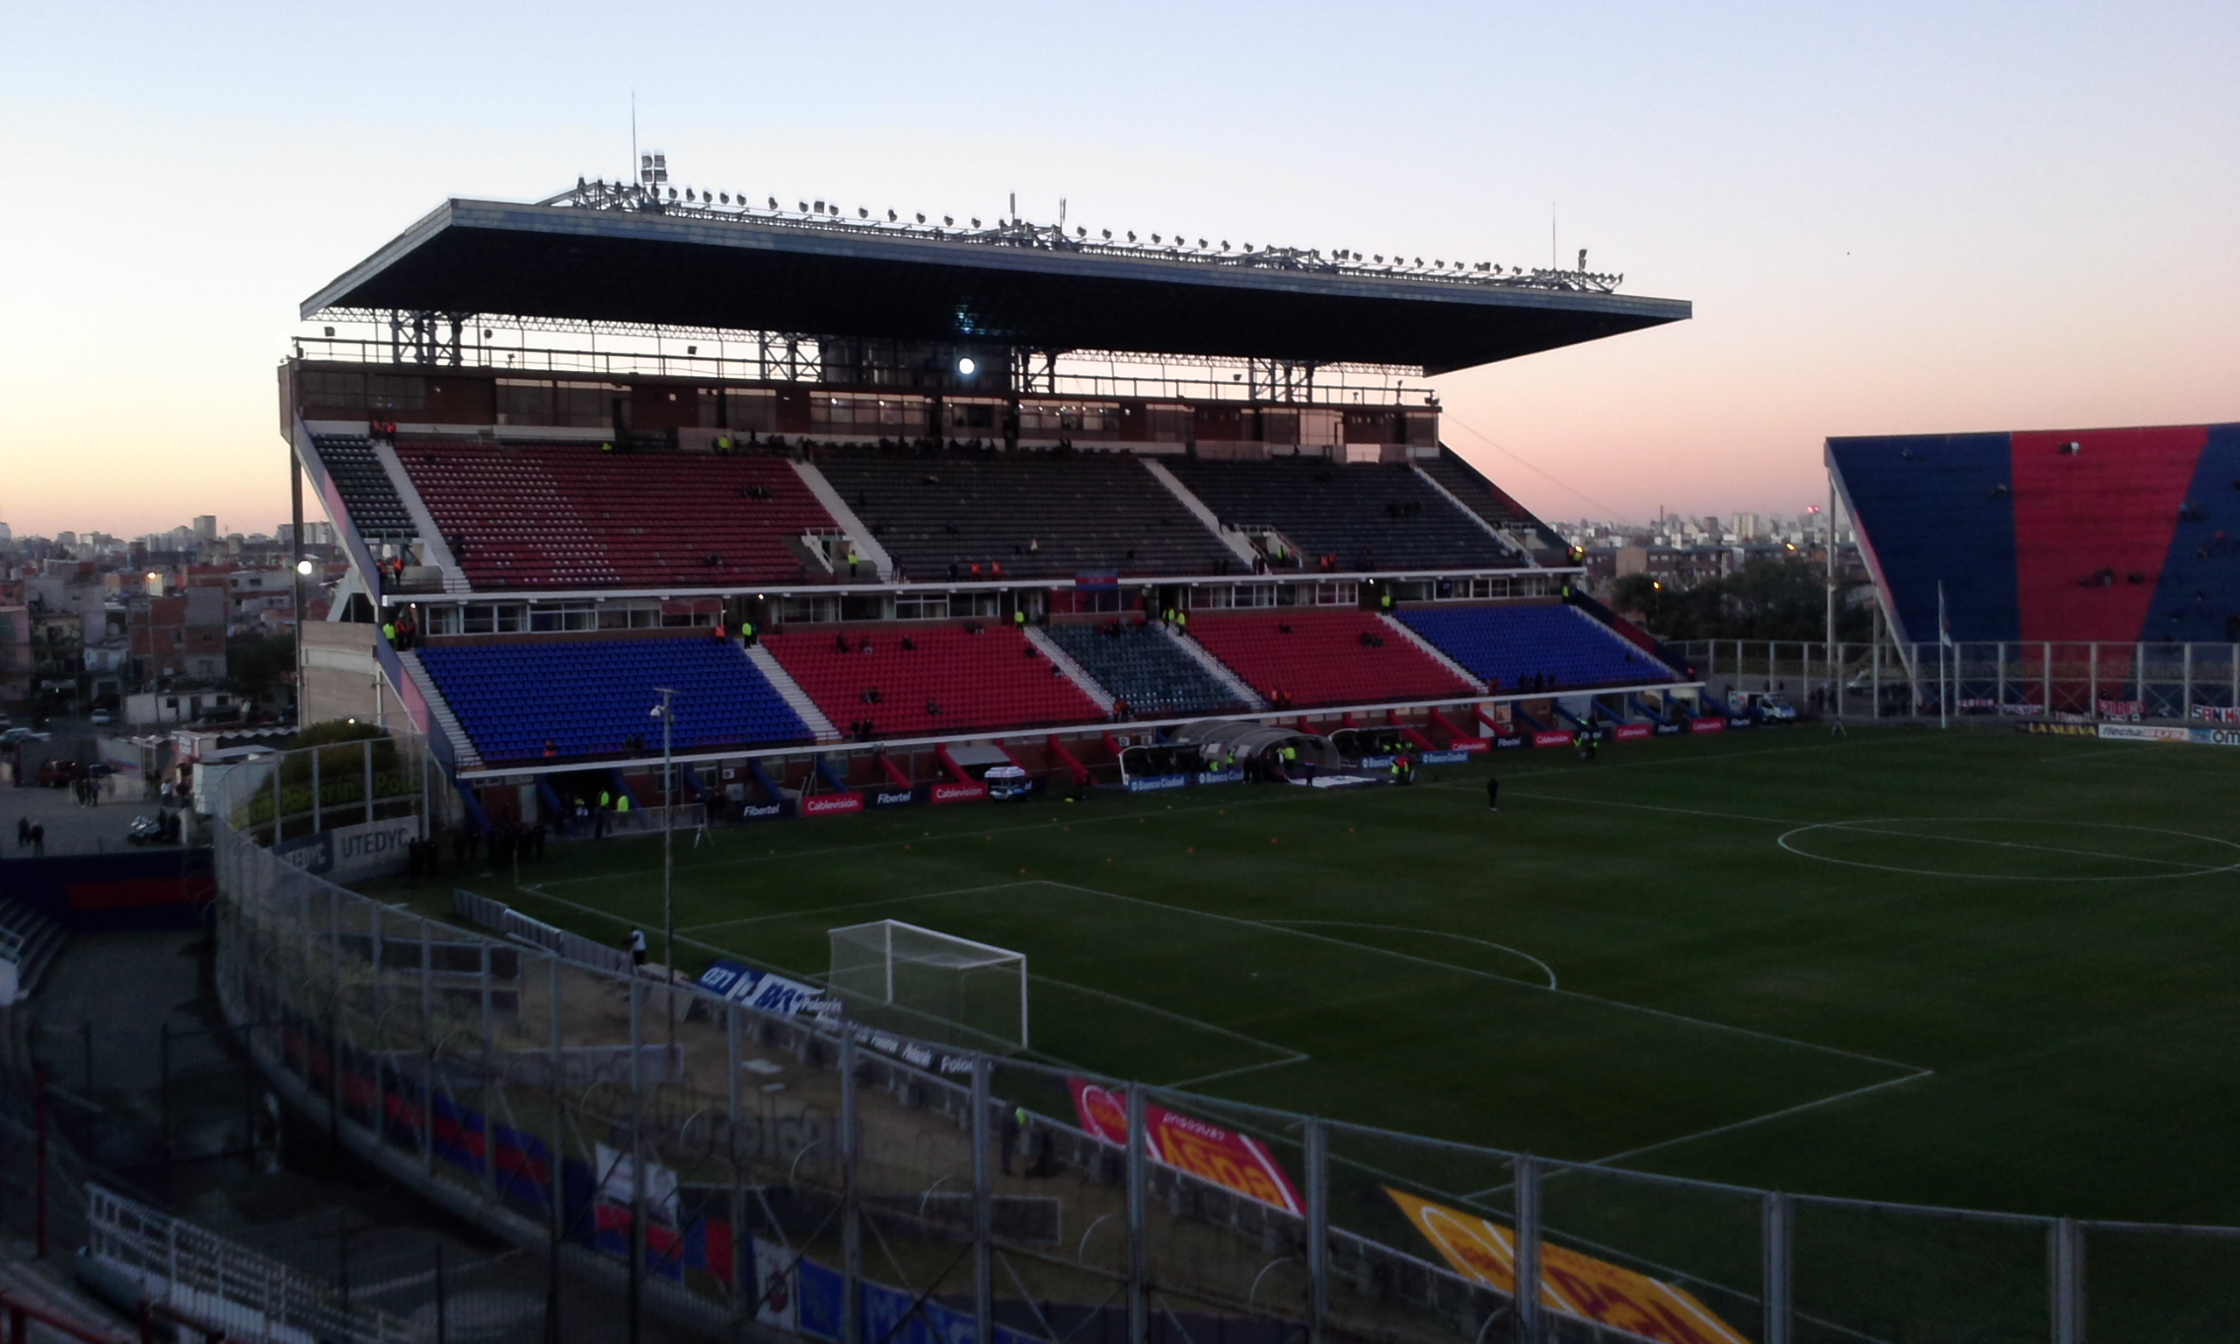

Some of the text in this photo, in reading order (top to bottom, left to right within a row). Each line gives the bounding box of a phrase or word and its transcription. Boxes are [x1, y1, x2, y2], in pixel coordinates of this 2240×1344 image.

[1138, 776, 1184, 791] Banco Ciudad
[877, 790, 912, 805] Fibertel
[935, 785, 983, 799] Cablevisión
[743, 803, 780, 818] Fibertel
[807, 796, 858, 812] Cablevisión
[341, 826, 409, 858] UTEDYC
